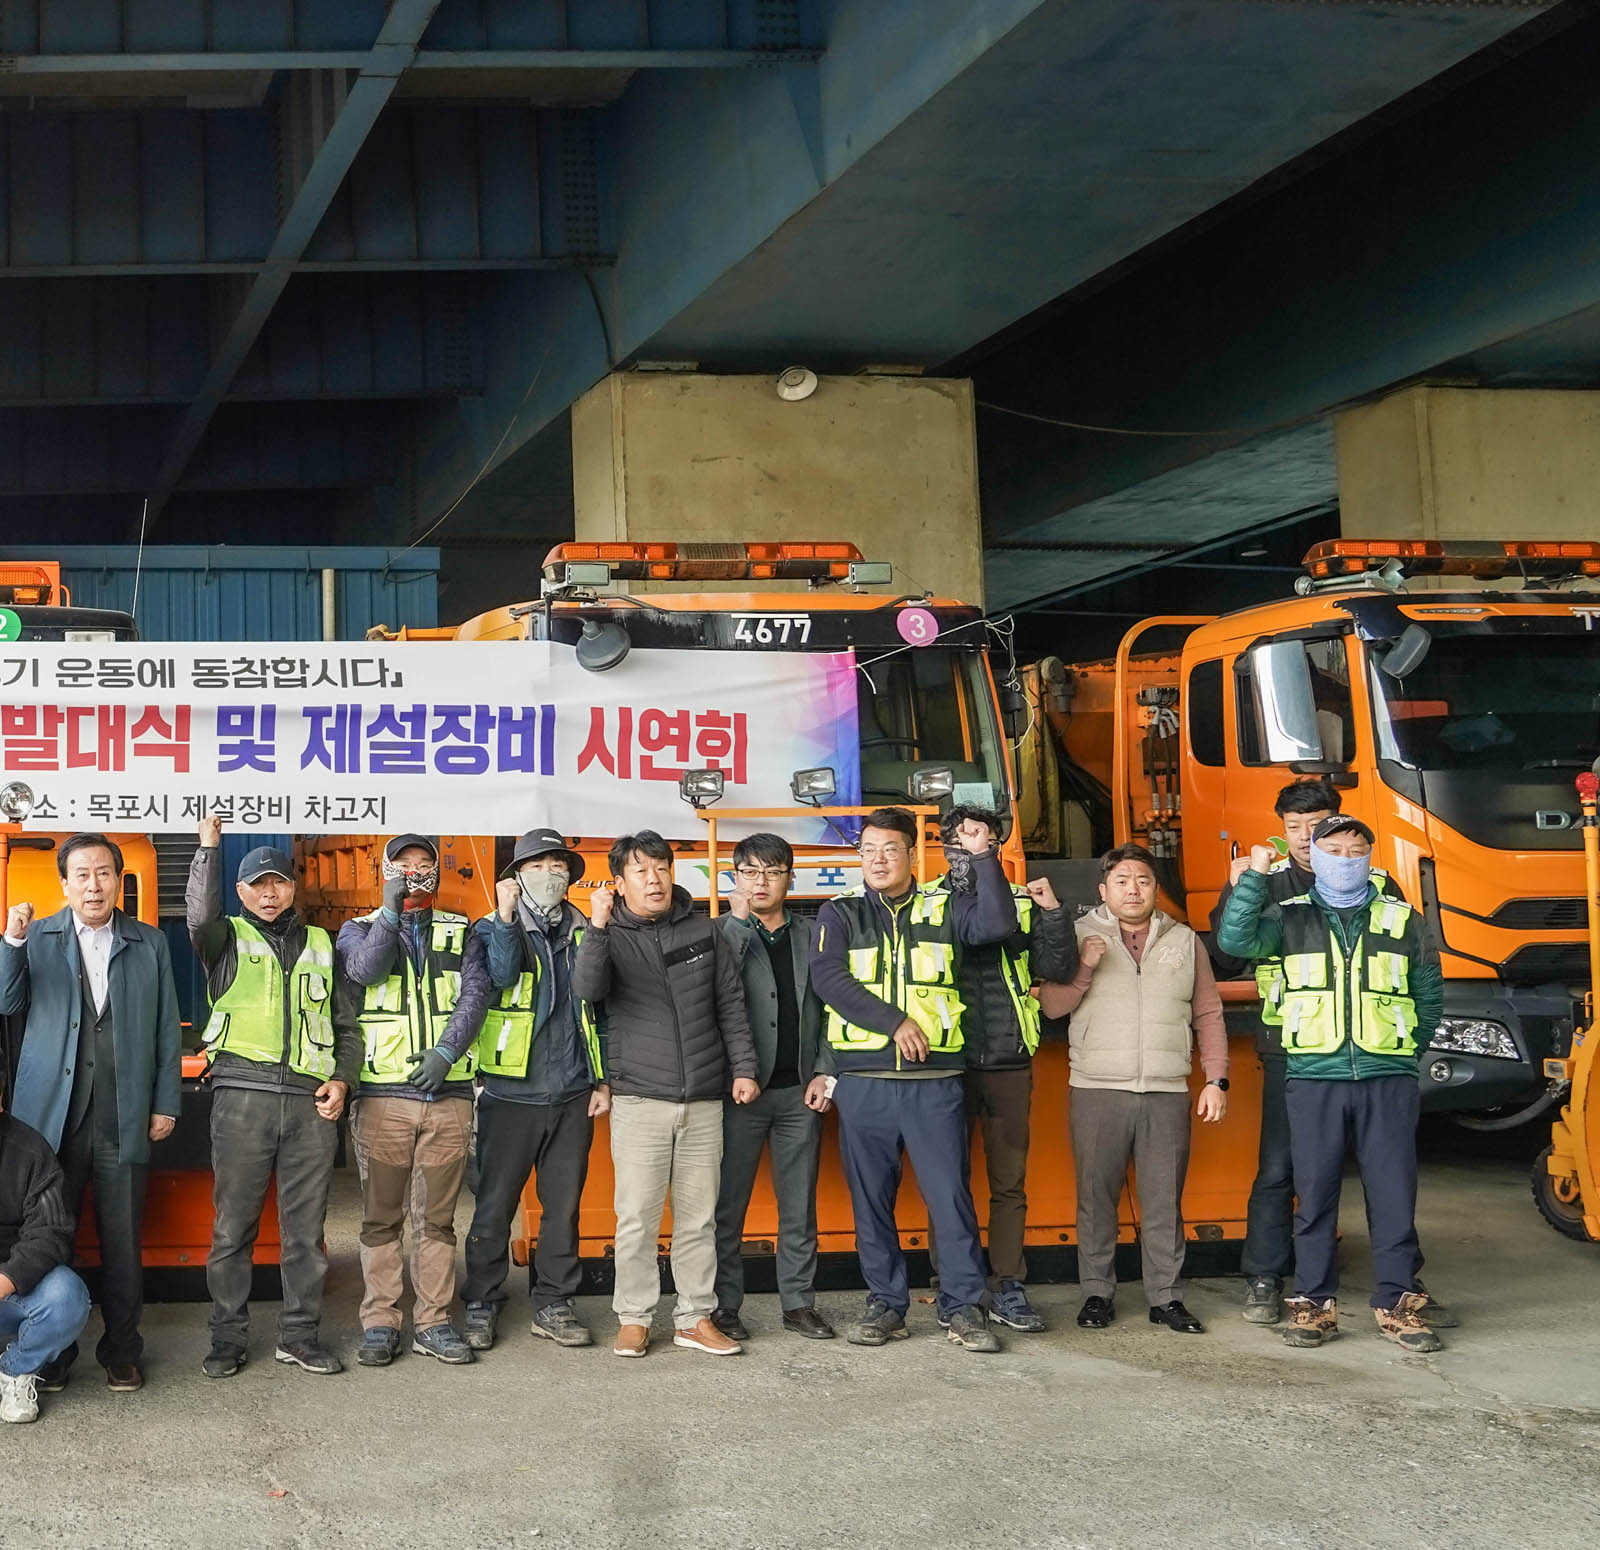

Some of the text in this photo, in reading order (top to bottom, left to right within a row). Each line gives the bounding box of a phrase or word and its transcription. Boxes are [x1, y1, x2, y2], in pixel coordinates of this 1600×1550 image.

[735, 618, 811, 643] 4677
[908, 614, 926, 638] 3
[55, 657, 176, 689] 운동에
[1, 704, 191, 773] 발대식
[216, 704, 276, 772] 및
[301, 703, 556, 775] 제설장비
[577, 706, 748, 785] 시연회
[87, 795, 169, 823] 목포시
[181, 795, 291, 824] 제설장비
[304, 795, 387, 825] 차고지
